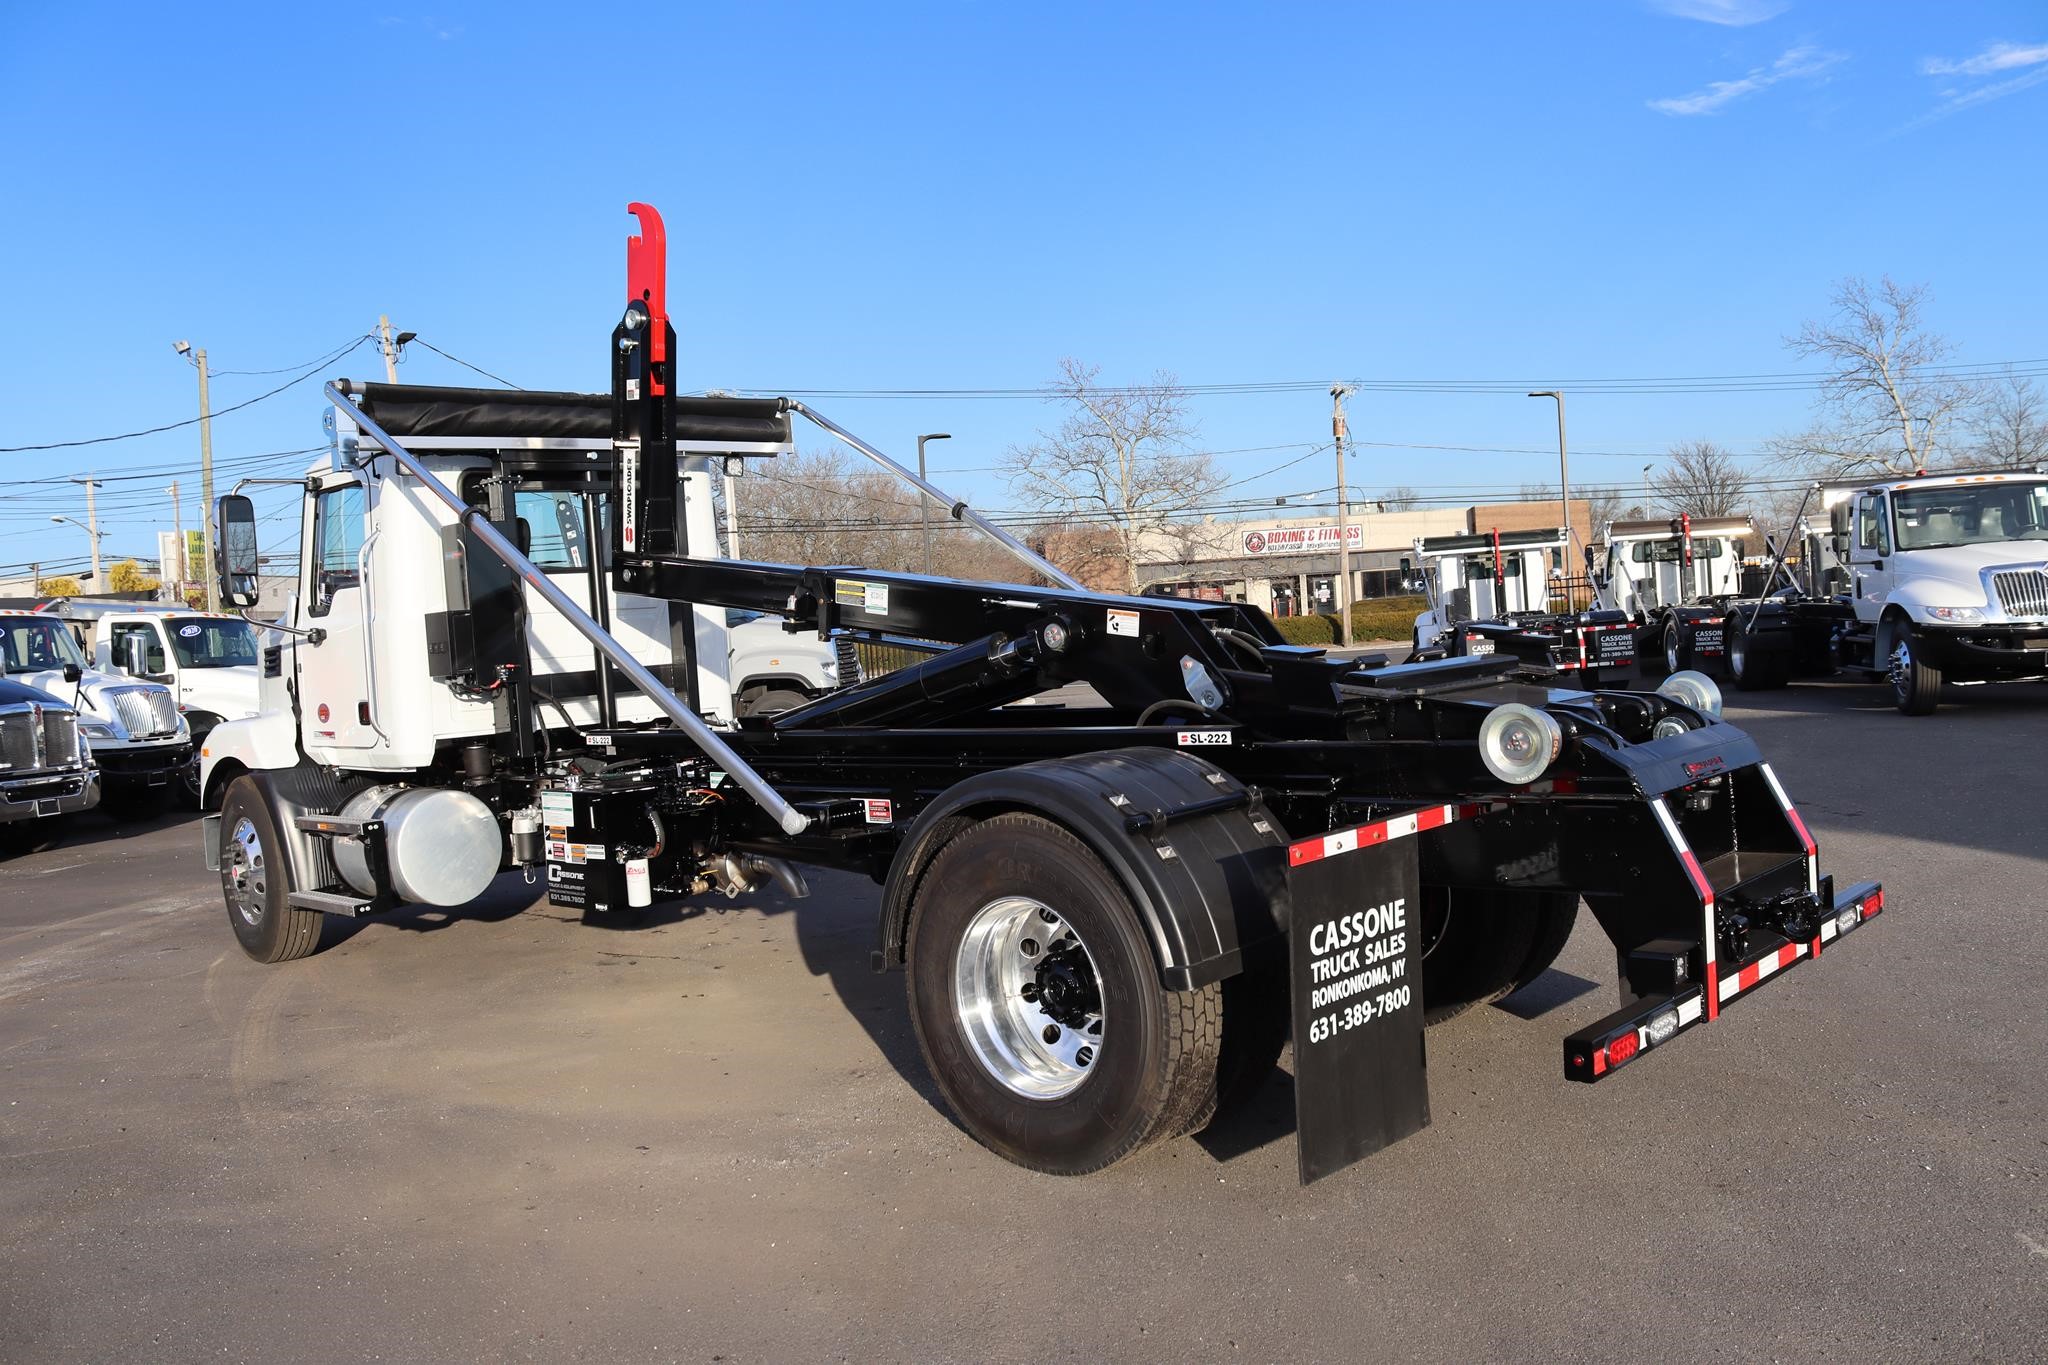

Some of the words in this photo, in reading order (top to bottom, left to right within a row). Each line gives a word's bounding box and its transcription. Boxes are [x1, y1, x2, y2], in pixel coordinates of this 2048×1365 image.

[1267, 531, 1305, 543] BOXING
[1308, 529, 1315, 541] &
[1318, 527, 1360, 541] FITNSS
[1601, 634, 1632, 642] CASSONE
[1309, 898, 1406, 956] CASSONE
[1310, 948, 1360, 983] TRUCK
[1364, 933, 1406, 965] SALES
[1312, 965, 1391, 1010] RONKONKOMA,
[1391, 958, 1406, 978] NY
[1309, 984, 1411, 1044] 631-389-7800
